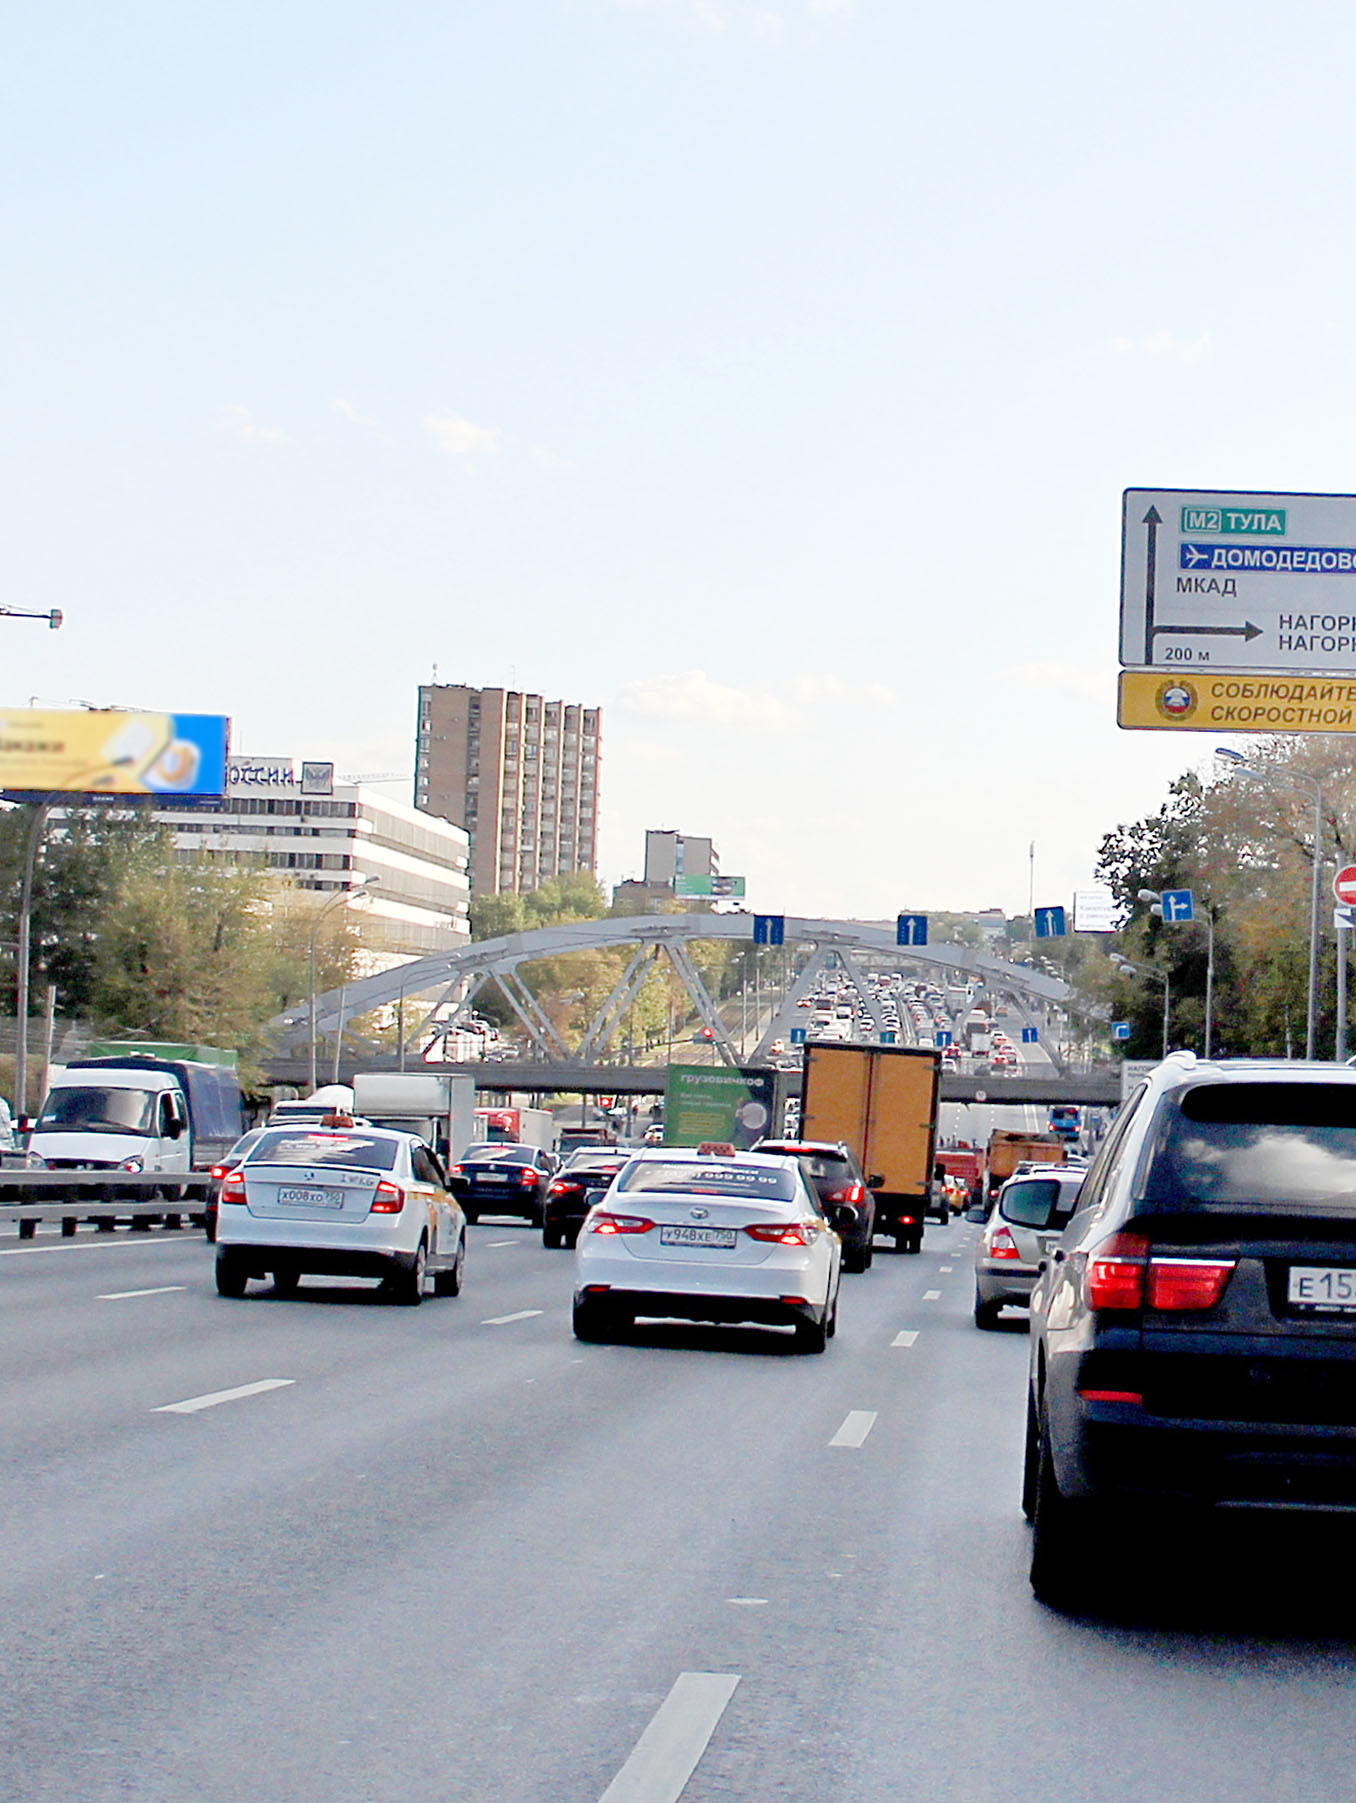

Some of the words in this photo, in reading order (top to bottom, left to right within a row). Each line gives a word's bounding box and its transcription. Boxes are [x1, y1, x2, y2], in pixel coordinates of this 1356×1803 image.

[1189, 512, 1219, 530] М2
[1226, 513, 1283, 531] ТУЛА
[1176, 577, 1238, 597] МКАД
[1165, 647, 1193, 661] 200
[1198, 651, 1210, 661] м
[1210, 704, 1353, 724] СКОРОСТНОЙ
[229, 765, 295, 787] ОССИИ
